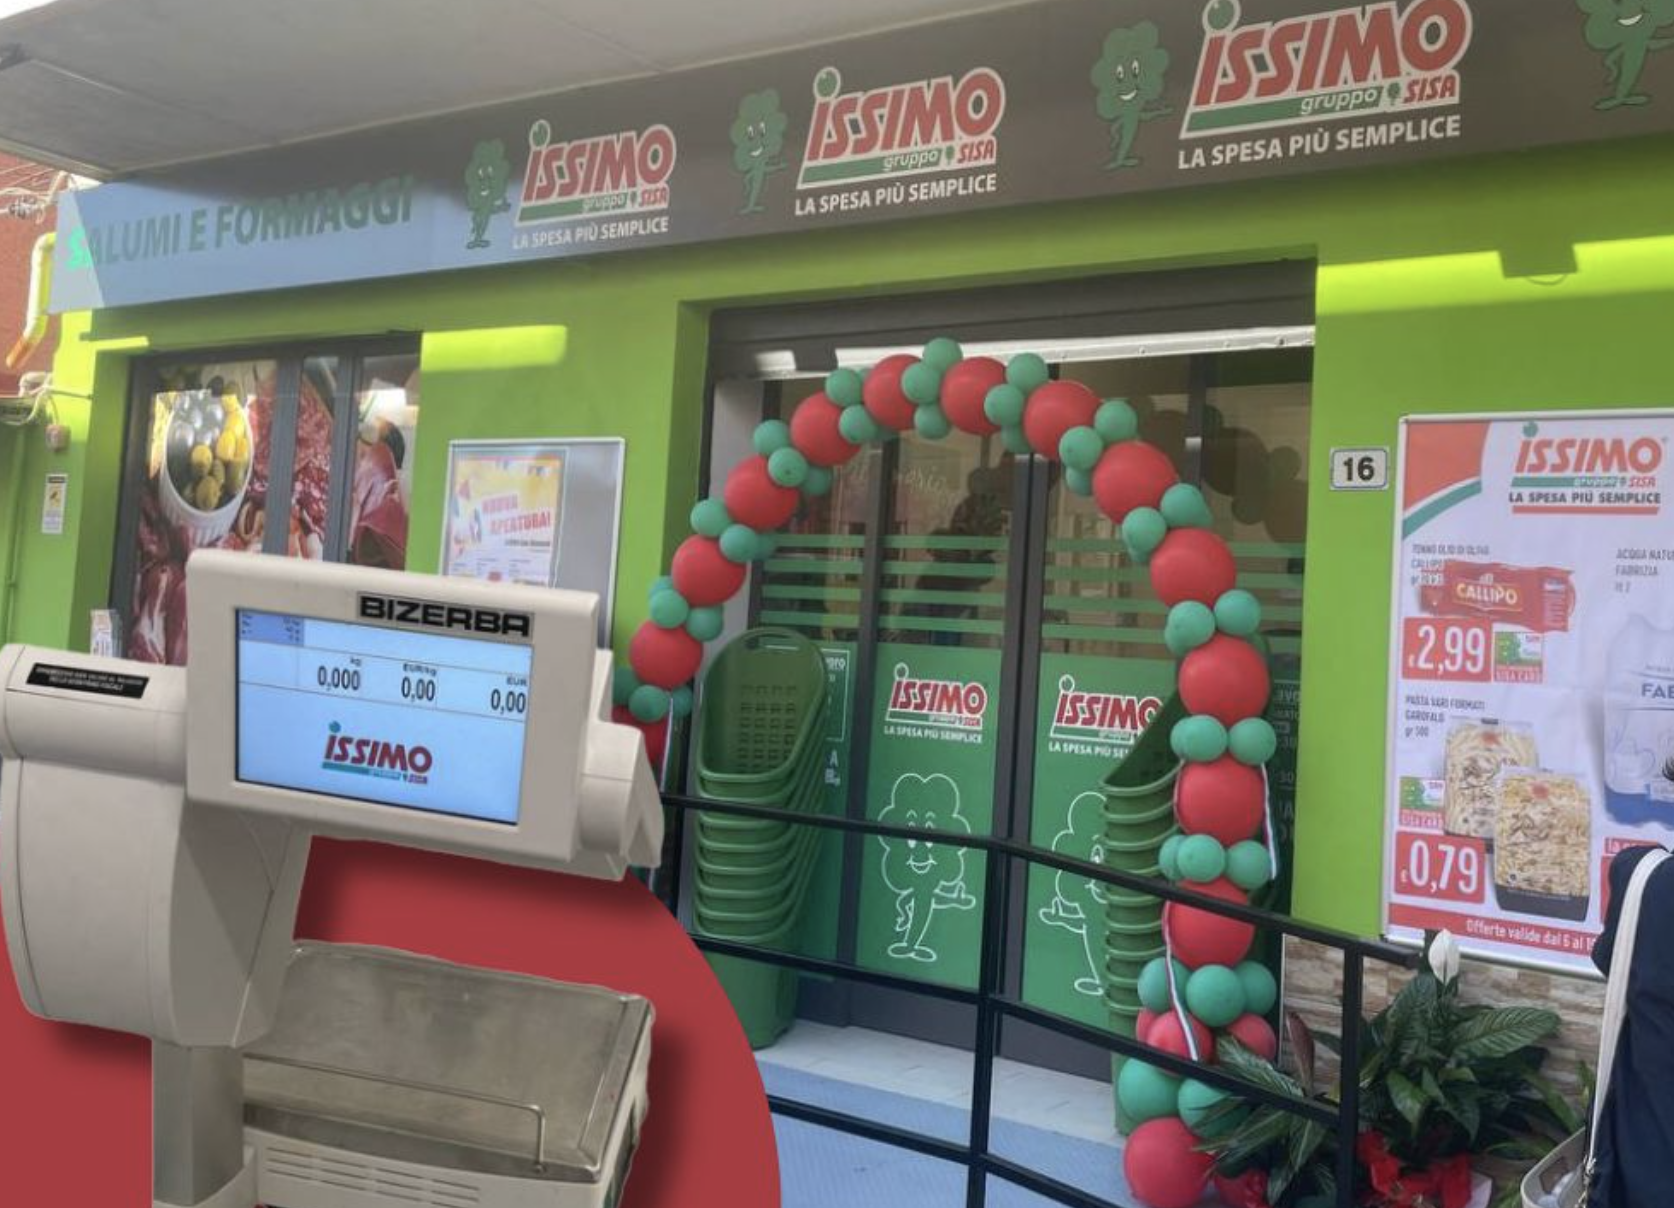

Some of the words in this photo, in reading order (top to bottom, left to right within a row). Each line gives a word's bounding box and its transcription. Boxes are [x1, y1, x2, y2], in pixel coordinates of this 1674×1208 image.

[1300, 87, 1378, 115] gruppo
[1402, 74, 1456, 104] SISA
[883, 149, 939, 173] gruppo
[957, 138, 995, 164] SISA
[1178, 148, 1206, 169] LA
[1211, 138, 1283, 166] SPESA
[1289, 127, 1329, 158] PIÙ
[1336, 114, 1461, 150] SEMPLICE
[795, 199, 816, 217] LA
[819, 190, 871, 213] SPESA
[875, 182, 905, 206] PIÙ
[908, 173, 997, 201] SEMPLICE
[188, 208, 207, 252] E
[215, 174, 414, 249] FORMAGGI
[512, 233, 529, 250] LA
[532, 228, 572, 248] SPESA
[575, 222, 599, 243] PIÙ
[601, 216, 670, 240] SEMPLICE
[1343, 456, 1376, 483] 16
[1508, 491, 1524, 503] LA
[1528, 491, 1567, 503] SPESA
[1571, 489, 1593, 503] PIÙ
[1599, 491, 1662, 504] SEMPLICE
[1456, 582, 1519, 605] CALLIPO
[359, 594, 531, 638] BIZERBA
[317, 664, 361, 692] 0,000
[401, 676, 436, 703] 0,00
[490, 688, 527, 715] 0,00
[506, 675, 528, 687] EUR
[884, 724, 895, 736] LA
[896, 726, 922, 738] SPESA
[941, 729, 983, 744] SEMPLICE
[1049, 740, 1061, 752] LA
[1063, 742, 1092, 755] SPESA
[1466, 918, 1506, 938] Offerte
[1508, 926, 1540, 943] valide
[1542, 930, 1562, 946] dal
